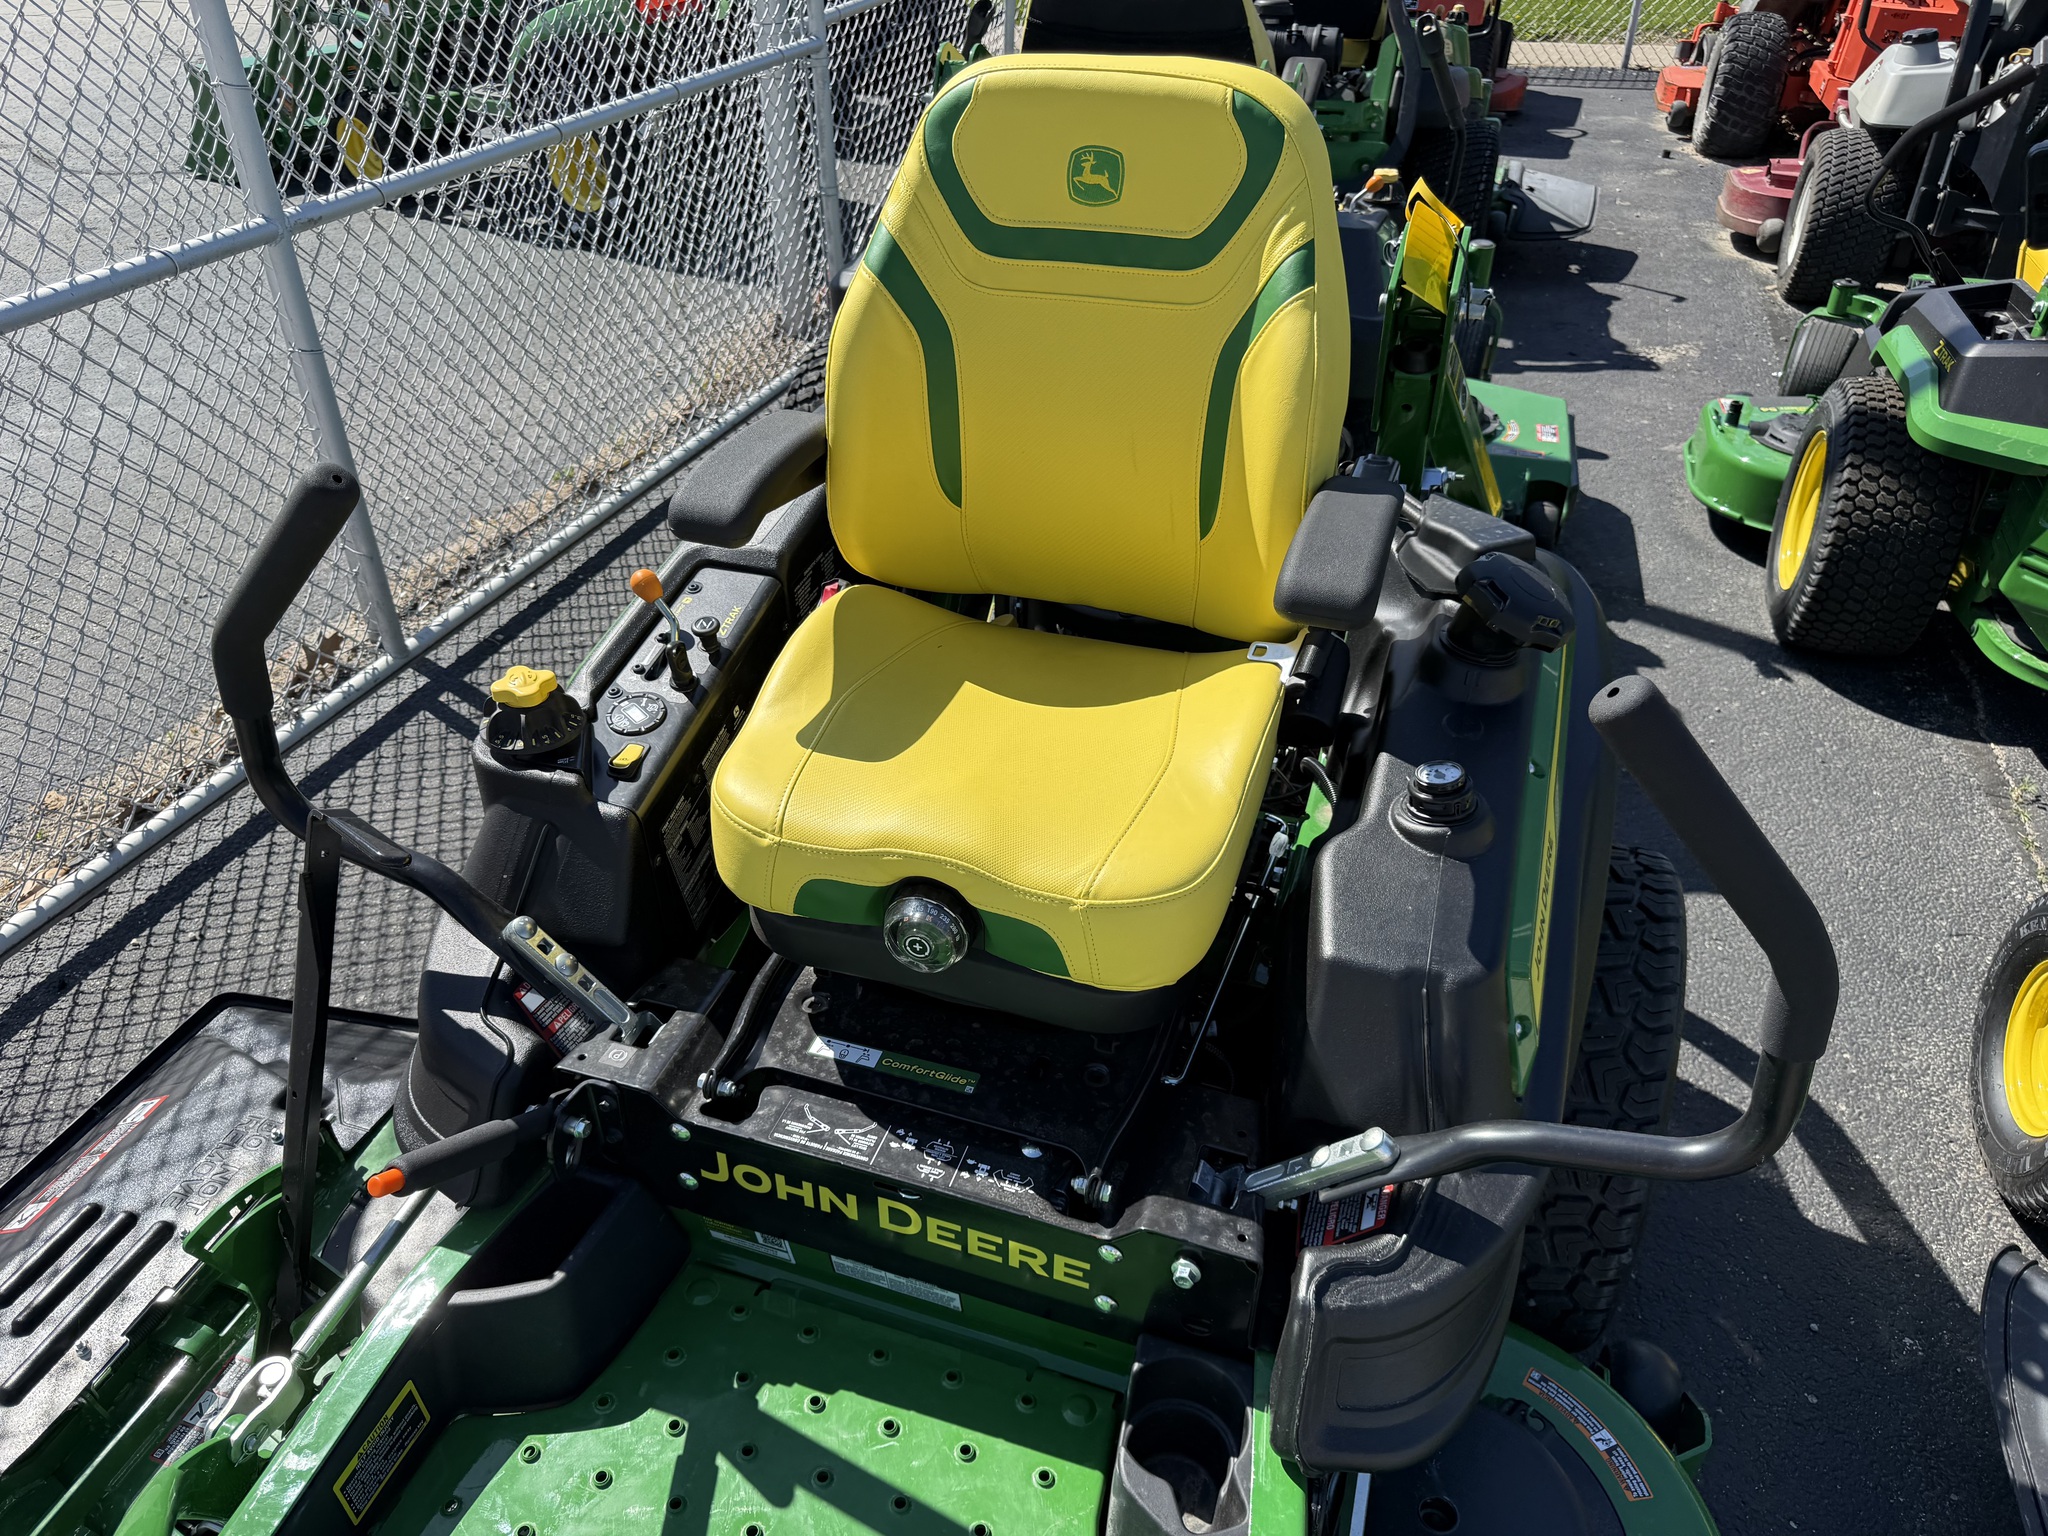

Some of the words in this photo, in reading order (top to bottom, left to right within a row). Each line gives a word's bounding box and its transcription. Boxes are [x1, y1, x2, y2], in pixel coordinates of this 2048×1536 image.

[1933, 338, 1956, 373] ZTRAK
[717, 603, 742, 637] ZTRAK
[926, 906, 938, 915] 190
[938, 913, 951, 923] 235
[1534, 909, 1546, 981] JOHN
[1541, 831, 1555, 909] DEERE
[557, 1002, 579, 1023] PELIGR
[160, 1116, 260, 1208] REMOVE
[187, 1163, 240, 1215] NOT
[701, 1152, 859, 1221] JOHN
[878, 1196, 1091, 1290] DEERE
[361, 1414, 388, 1452] CAUTION
[1605, 1456, 1625, 1486] WARNING
